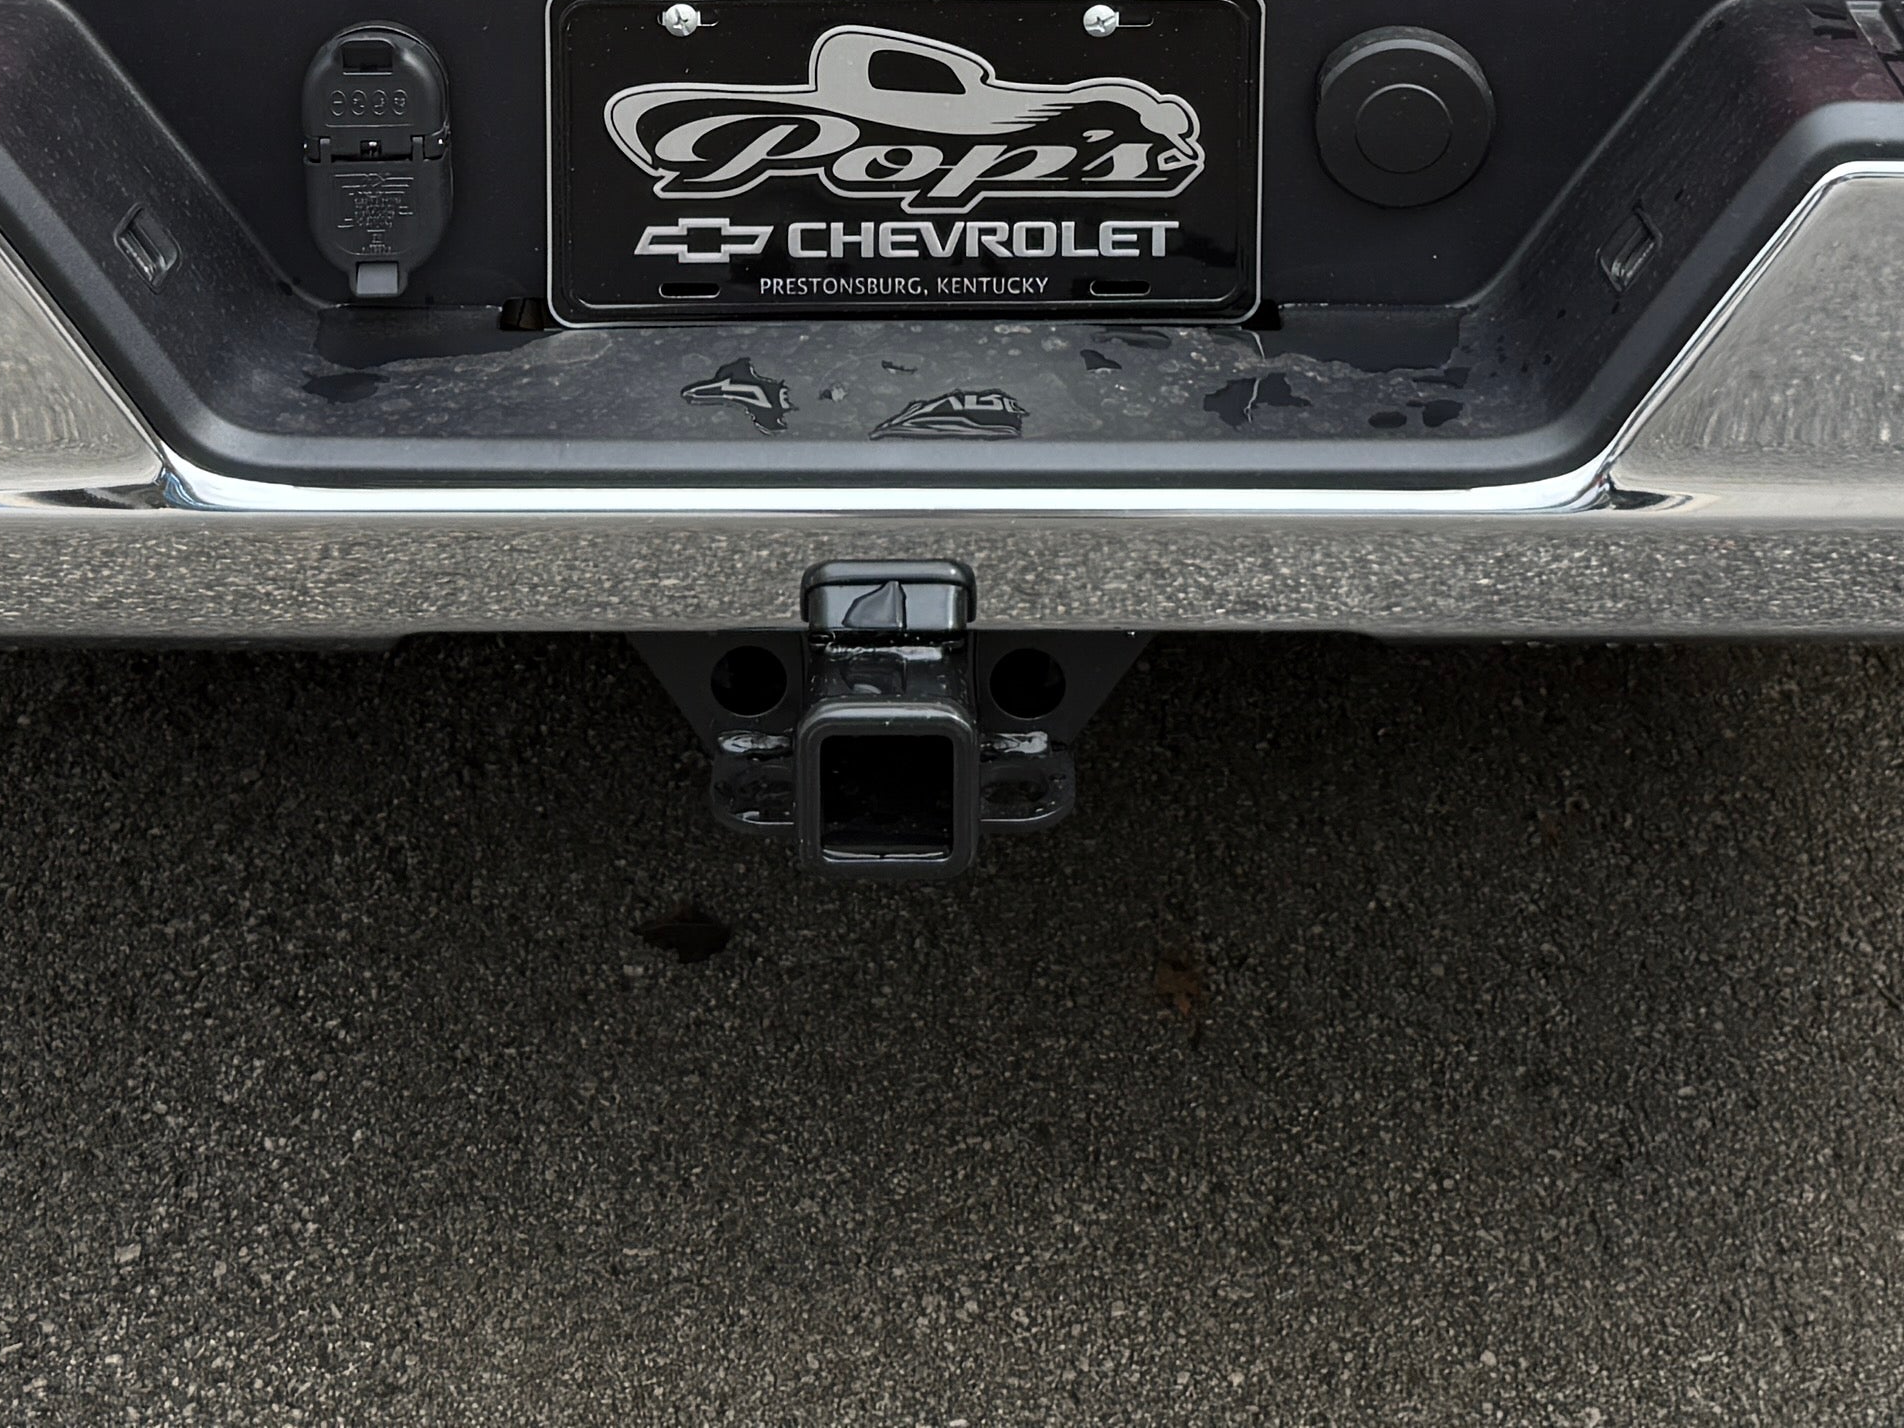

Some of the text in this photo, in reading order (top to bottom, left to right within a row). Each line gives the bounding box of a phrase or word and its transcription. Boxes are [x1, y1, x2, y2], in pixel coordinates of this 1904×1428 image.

[653, 113, 1164, 198] Pop's
[787, 220, 1180, 259] CHEVROLET
[759, 276, 1049, 297] PRESTONSBURG, KENTUCKY
